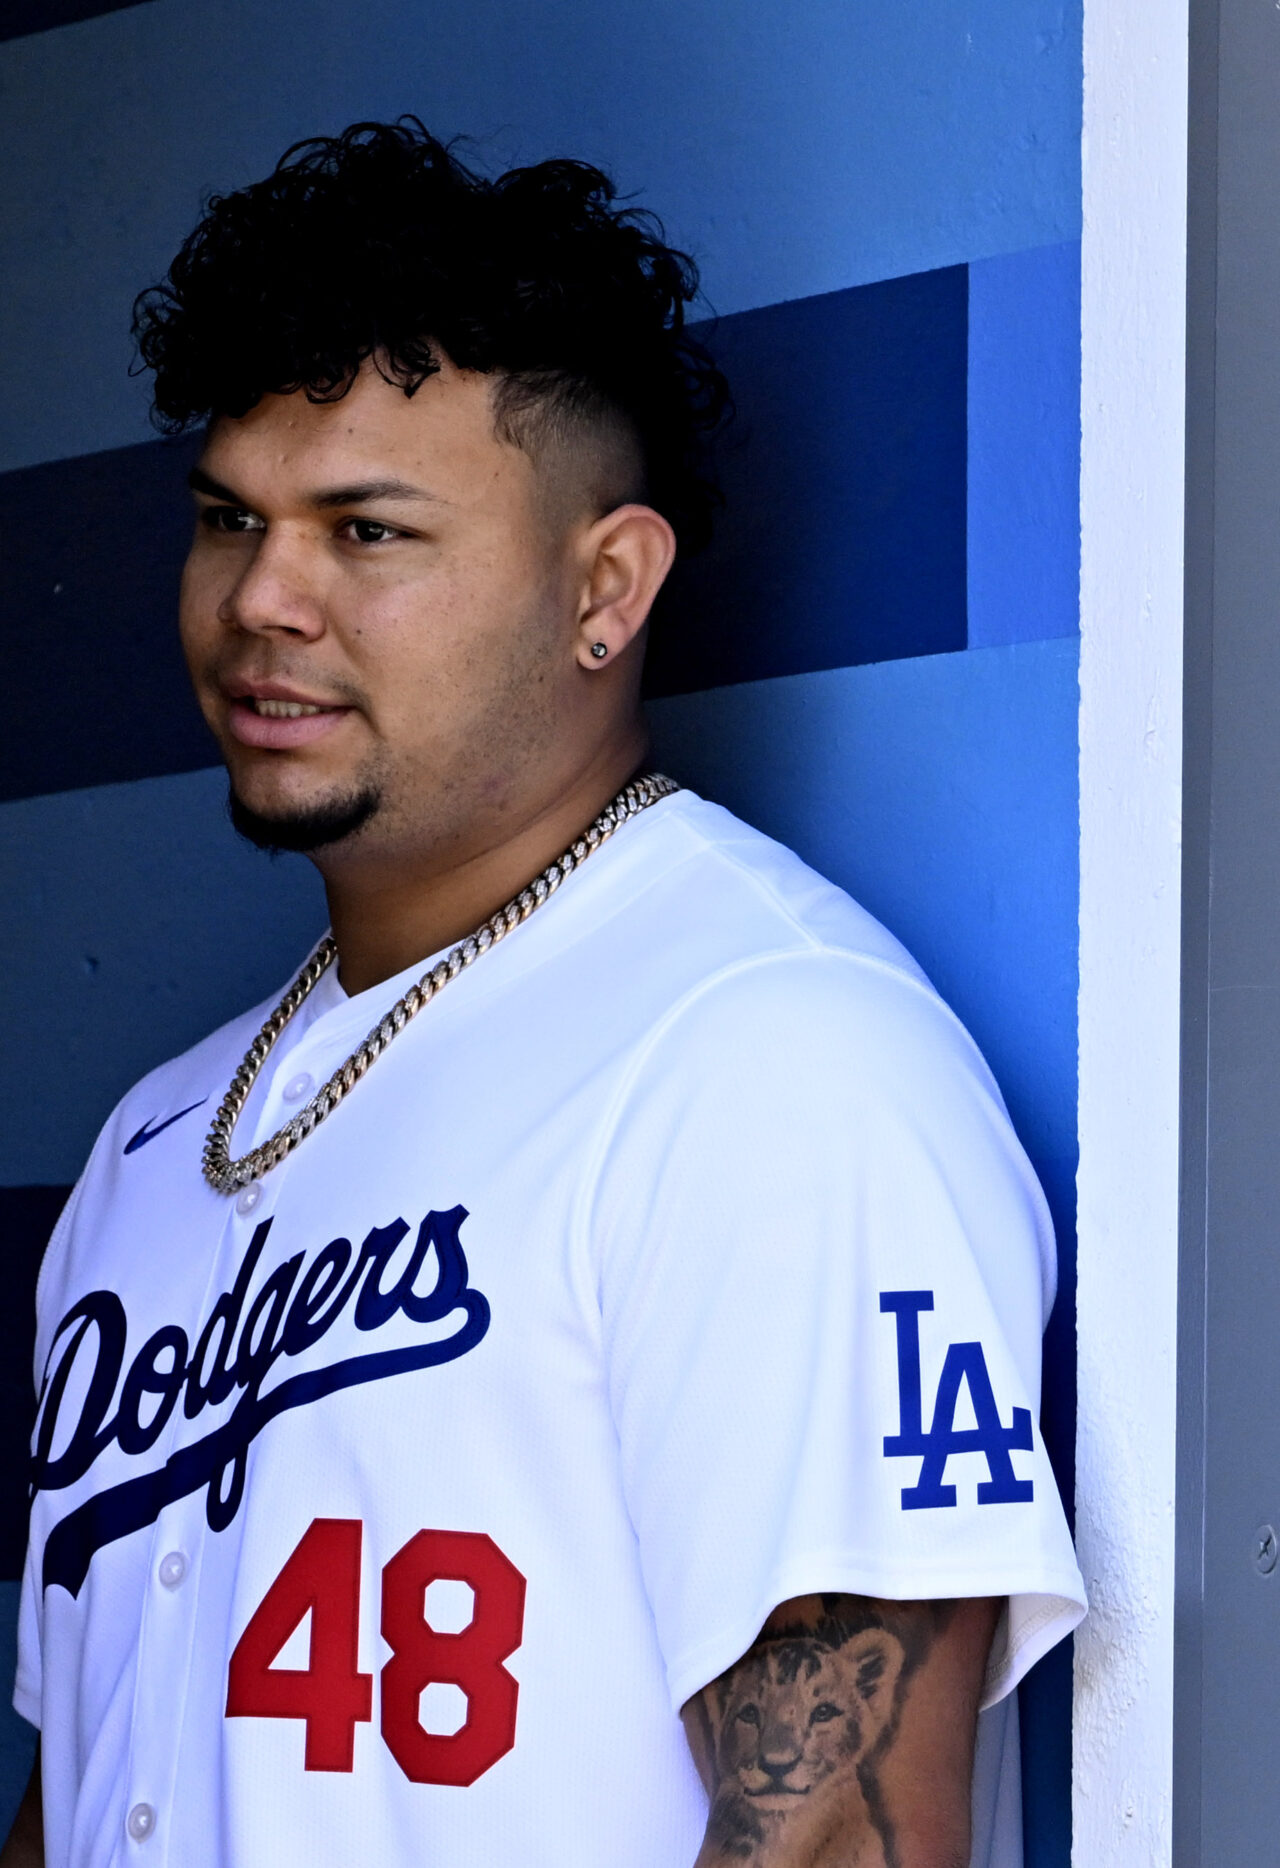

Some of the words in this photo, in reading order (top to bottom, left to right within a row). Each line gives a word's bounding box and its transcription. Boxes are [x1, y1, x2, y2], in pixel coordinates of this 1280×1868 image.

[28, 1205, 490, 1599] Dodgers
[879, 1290, 1034, 1510] LA
[225, 1518, 527, 1788] 48
